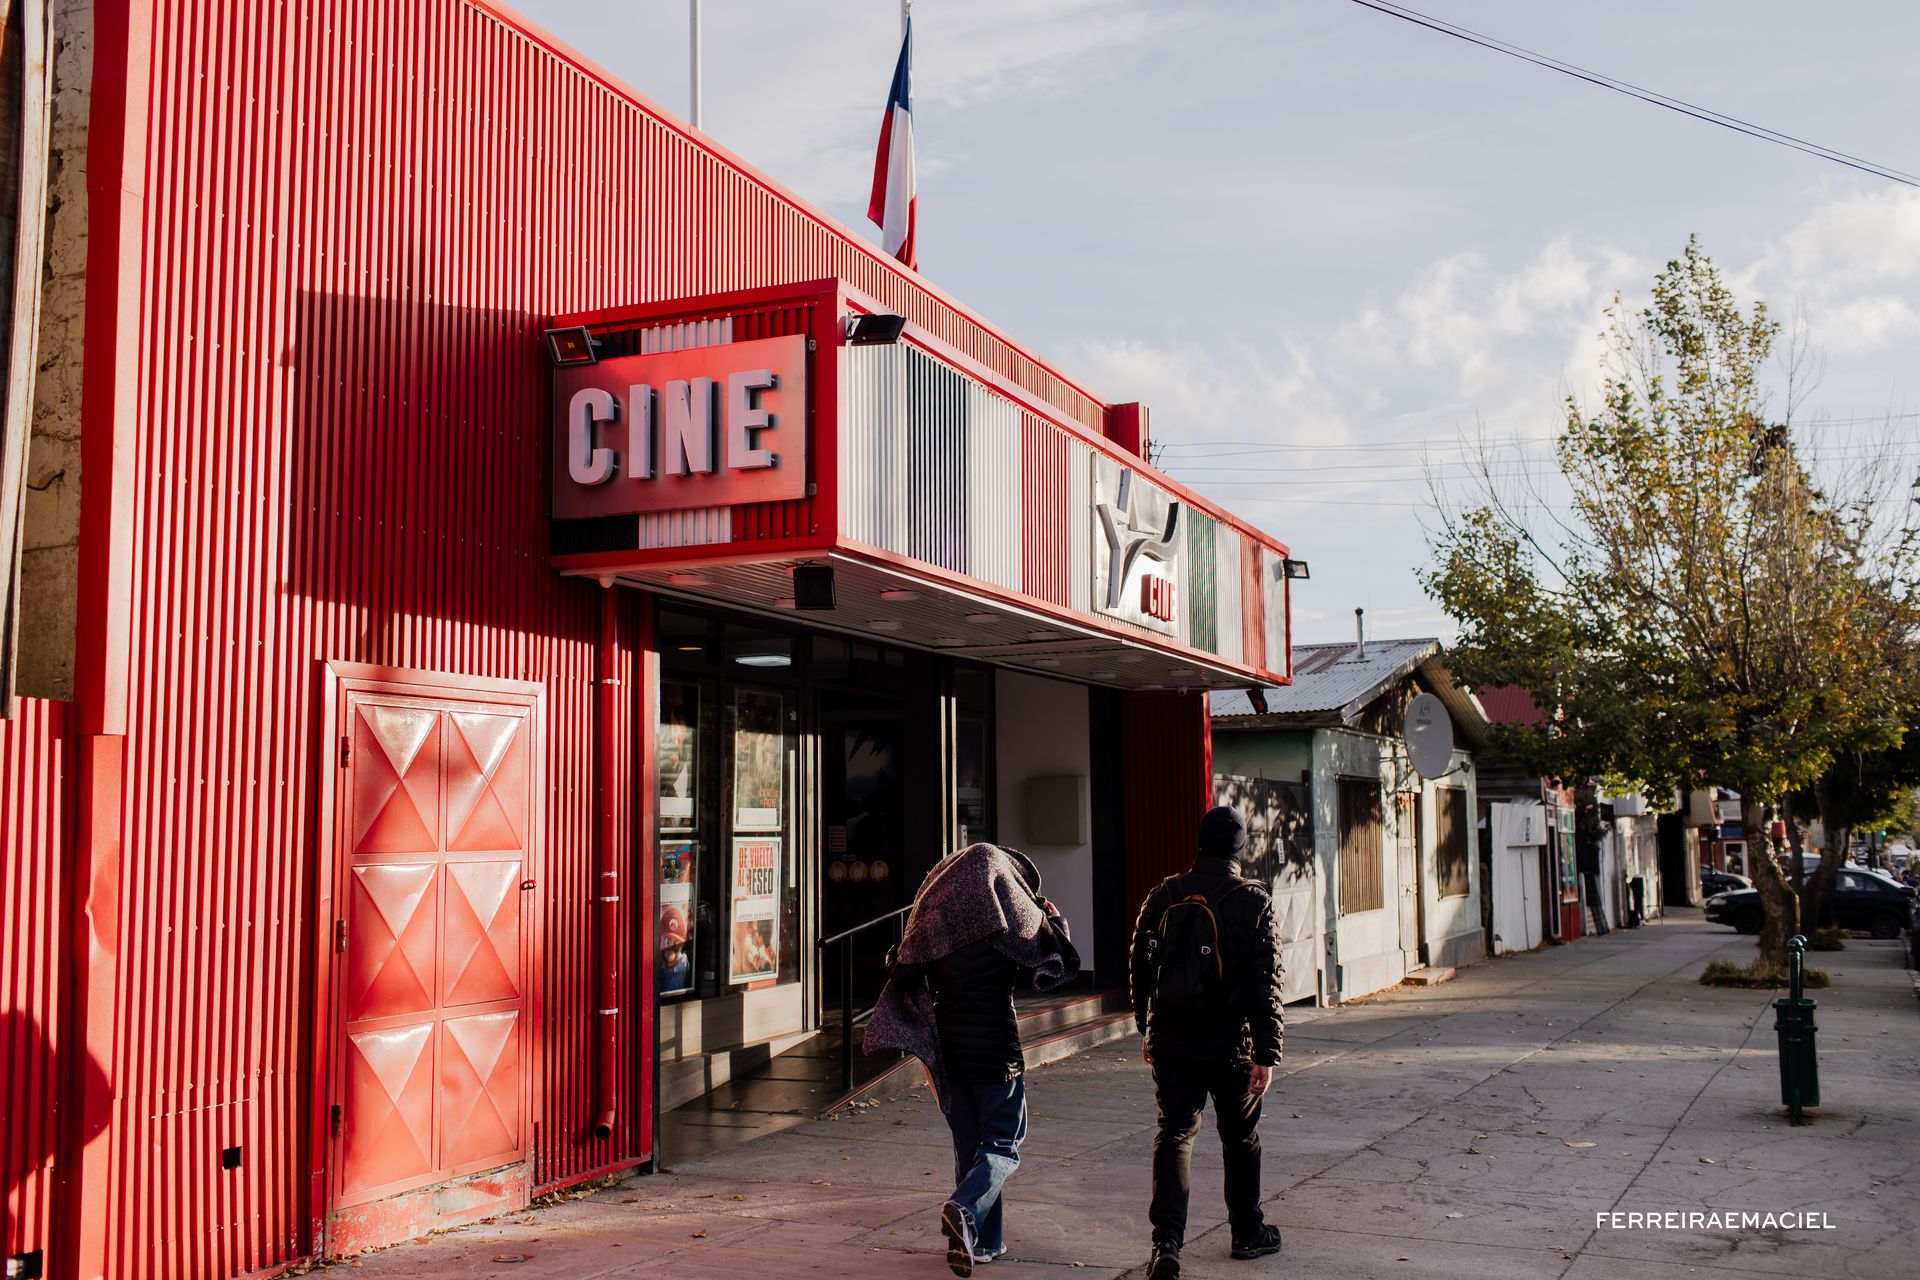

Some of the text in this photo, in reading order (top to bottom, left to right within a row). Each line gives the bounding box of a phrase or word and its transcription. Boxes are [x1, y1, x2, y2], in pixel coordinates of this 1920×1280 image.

[569, 368, 772, 486] CINE
[739, 847, 774, 868] DE VUELTA
[737, 868, 745, 887] AL
